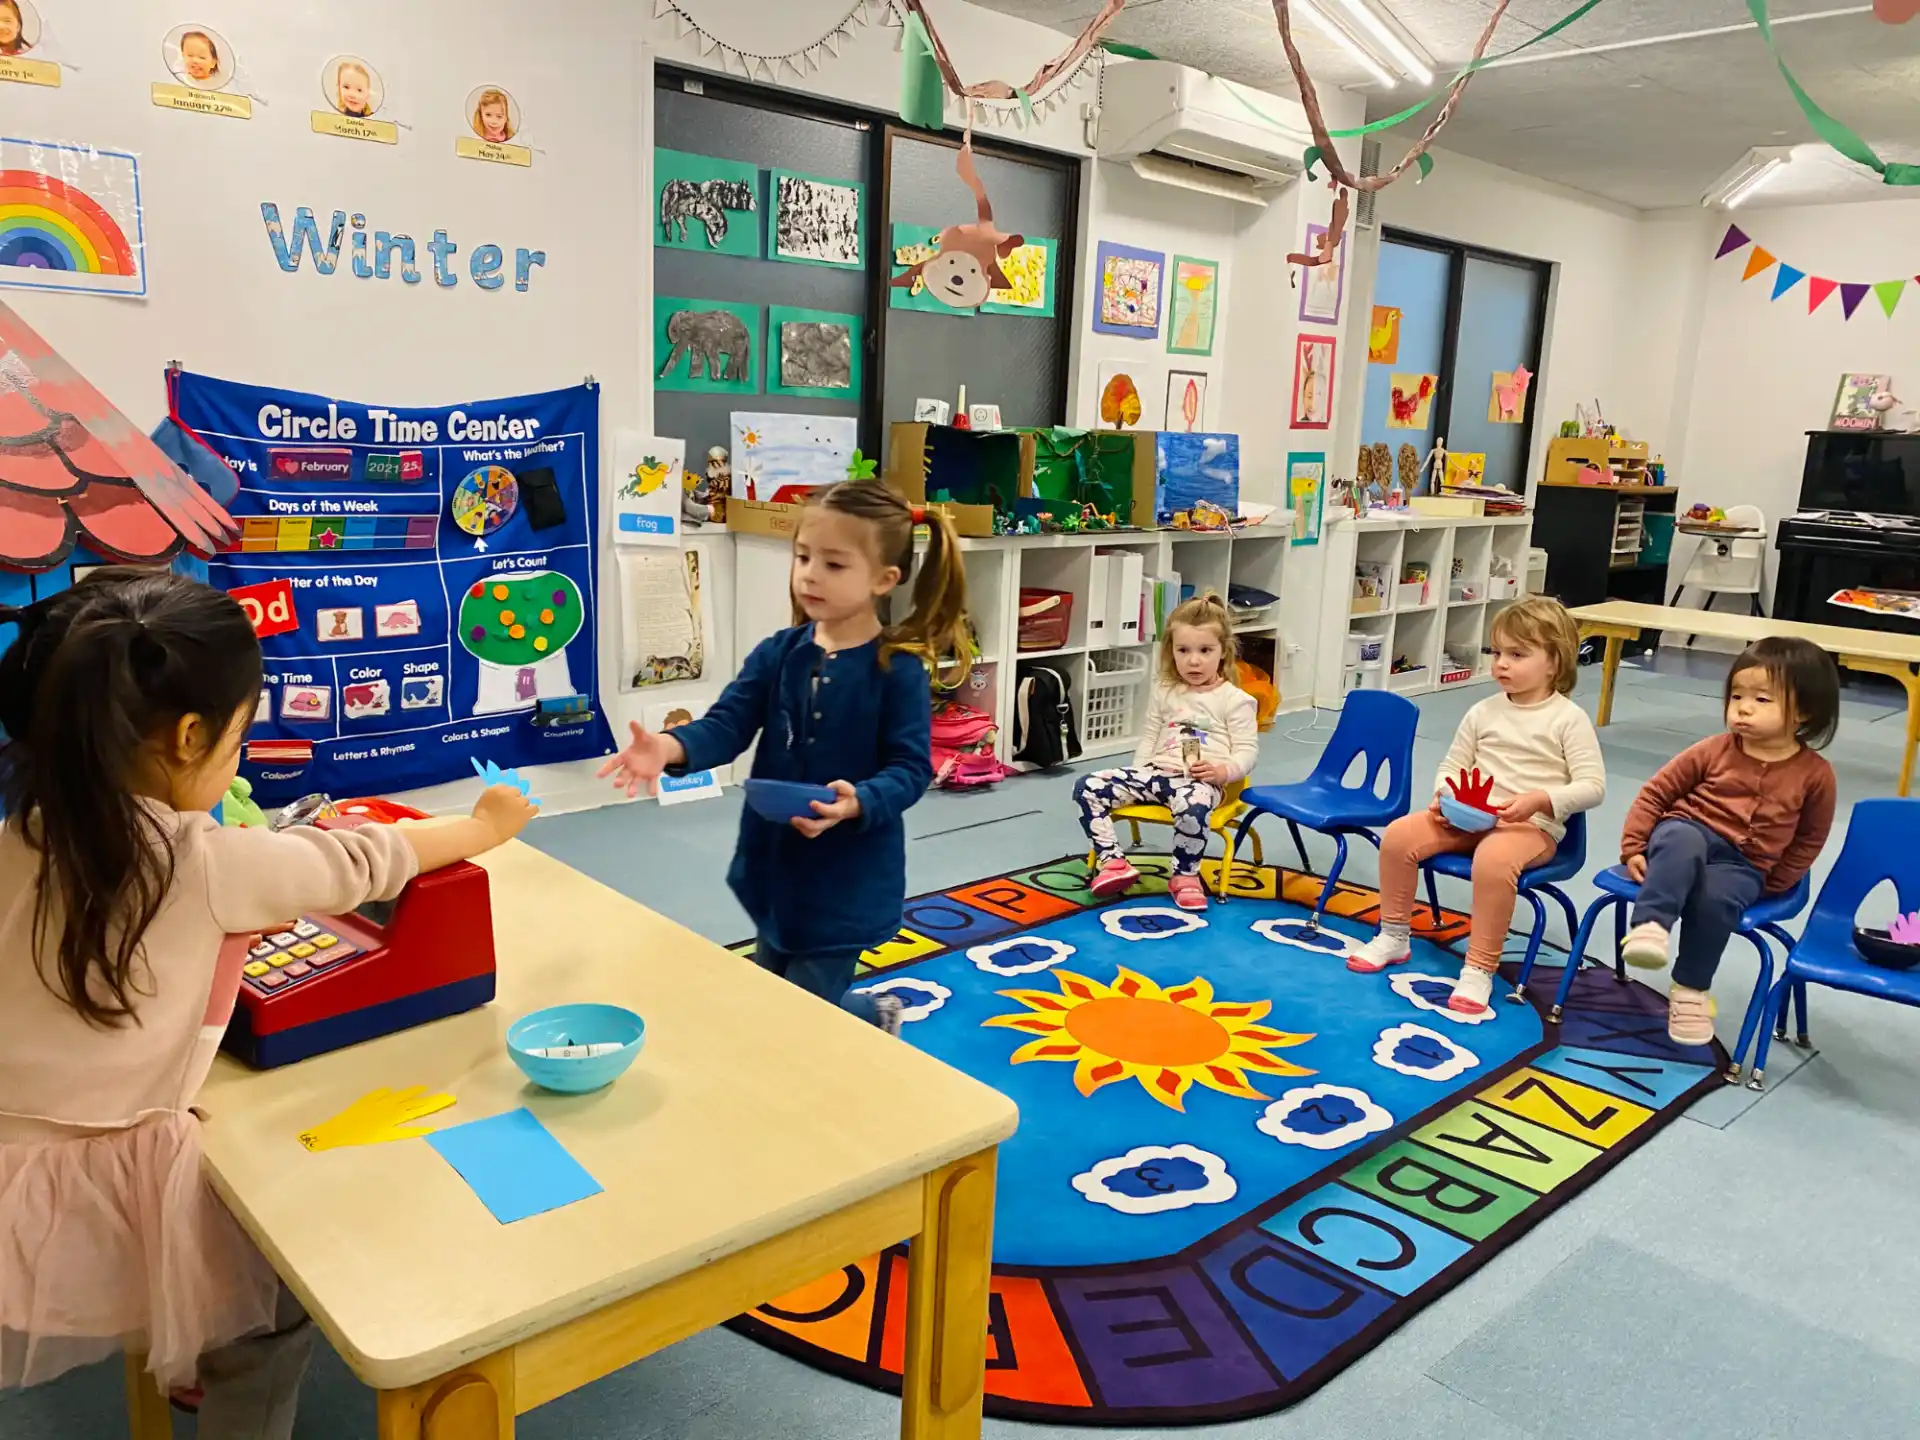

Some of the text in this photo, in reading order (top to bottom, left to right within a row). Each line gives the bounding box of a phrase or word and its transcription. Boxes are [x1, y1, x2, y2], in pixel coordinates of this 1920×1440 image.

[173, 98, 211, 111] January
[335, 124, 360, 136] March
[260, 201, 546, 292] Winter
[258, 403, 540, 443] Circle Time Center
[463, 449, 502, 461] What's
[504, 449, 522, 460] the
[248, 459, 257, 472] is
[301, 461, 418, 474] February 2021 25
[269, 499, 378, 514] Days of the Week
[636, 516, 658, 532] frog
[492, 556, 547, 570] Let's Count
[315, 576, 329, 587] of
[332, 576, 352, 587] the
[354, 575, 378, 588] Day
[349, 667, 382, 680] Color
[403, 662, 439, 674] Shape
[282, 673, 313, 684] Time
[441, 725, 510, 743] Colors & Shapes
[543, 728, 584, 738] Counting
[333, 743, 416, 761] Letters & Rhymes
[261, 770, 305, 780] Calendar
[670, 775, 704, 789] monkey
[973, 888, 1029, 914] P
[1564, 1057, 1664, 1098] Y
[1502, 1077, 1619, 1131] Z
[1299, 1103, 1348, 1126] 2
[1436, 1112, 1553, 1165] A
[1135, 1166, 1175, 1193] 3
[1376, 1155, 1500, 1215] B
[1298, 1206, 1417, 1271] C
[1229, 1245, 1366, 1320] D
[1082, 1286, 1215, 1369] E
